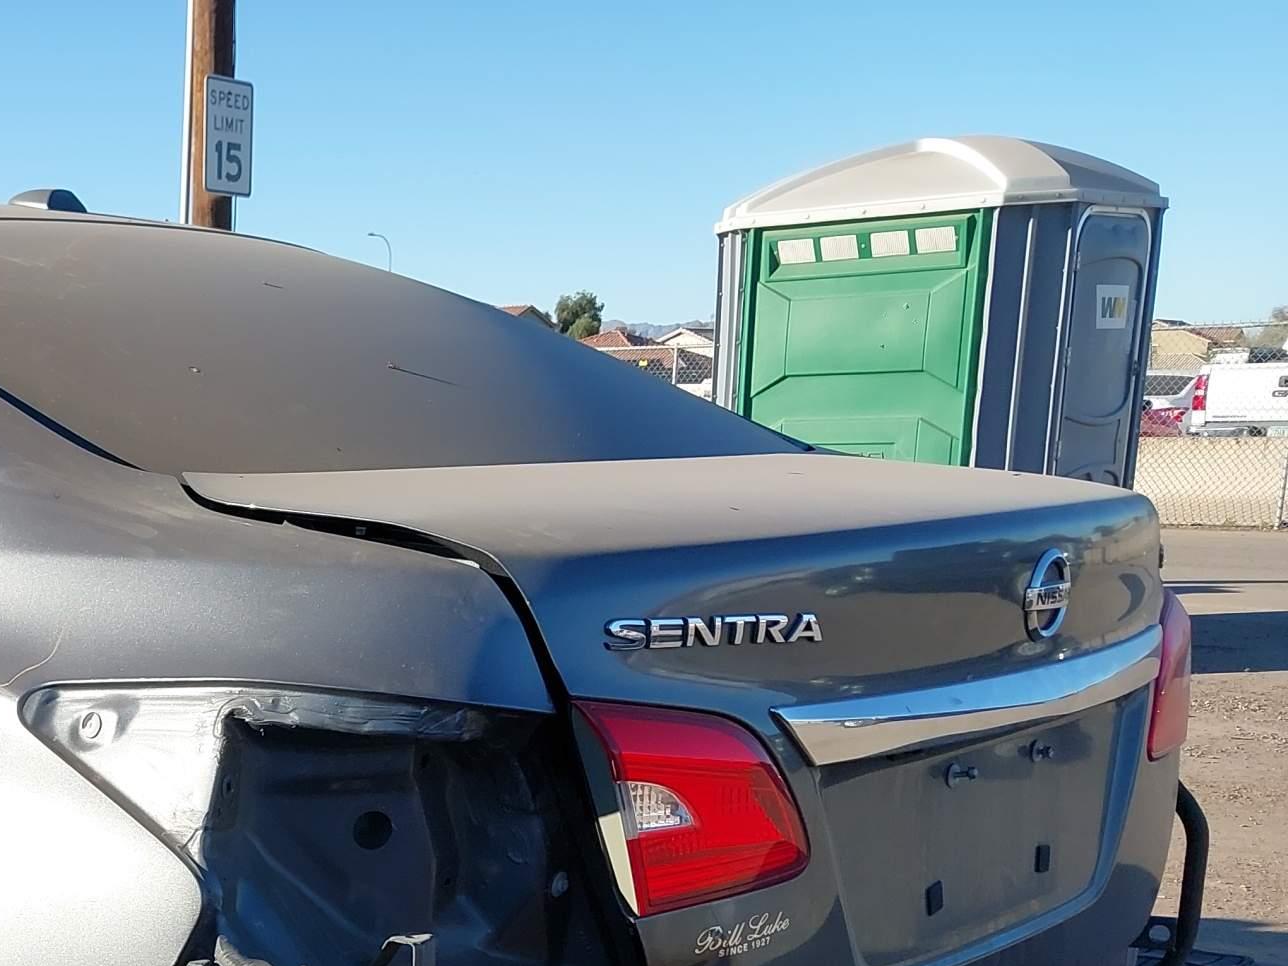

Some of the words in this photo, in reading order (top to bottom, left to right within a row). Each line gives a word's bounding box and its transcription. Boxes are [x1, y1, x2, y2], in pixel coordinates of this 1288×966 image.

[209, 89, 250, 110] SPEED
[214, 115, 245, 134] LIMIT
[215, 140, 242, 182] 15
[604, 612, 823, 650] SENTRA
[695, 922, 745, 954] Bill
[747, 911, 790, 941] Luke
[718, 943, 748, 957] SINCE
[752, 936, 770, 949] 1927
